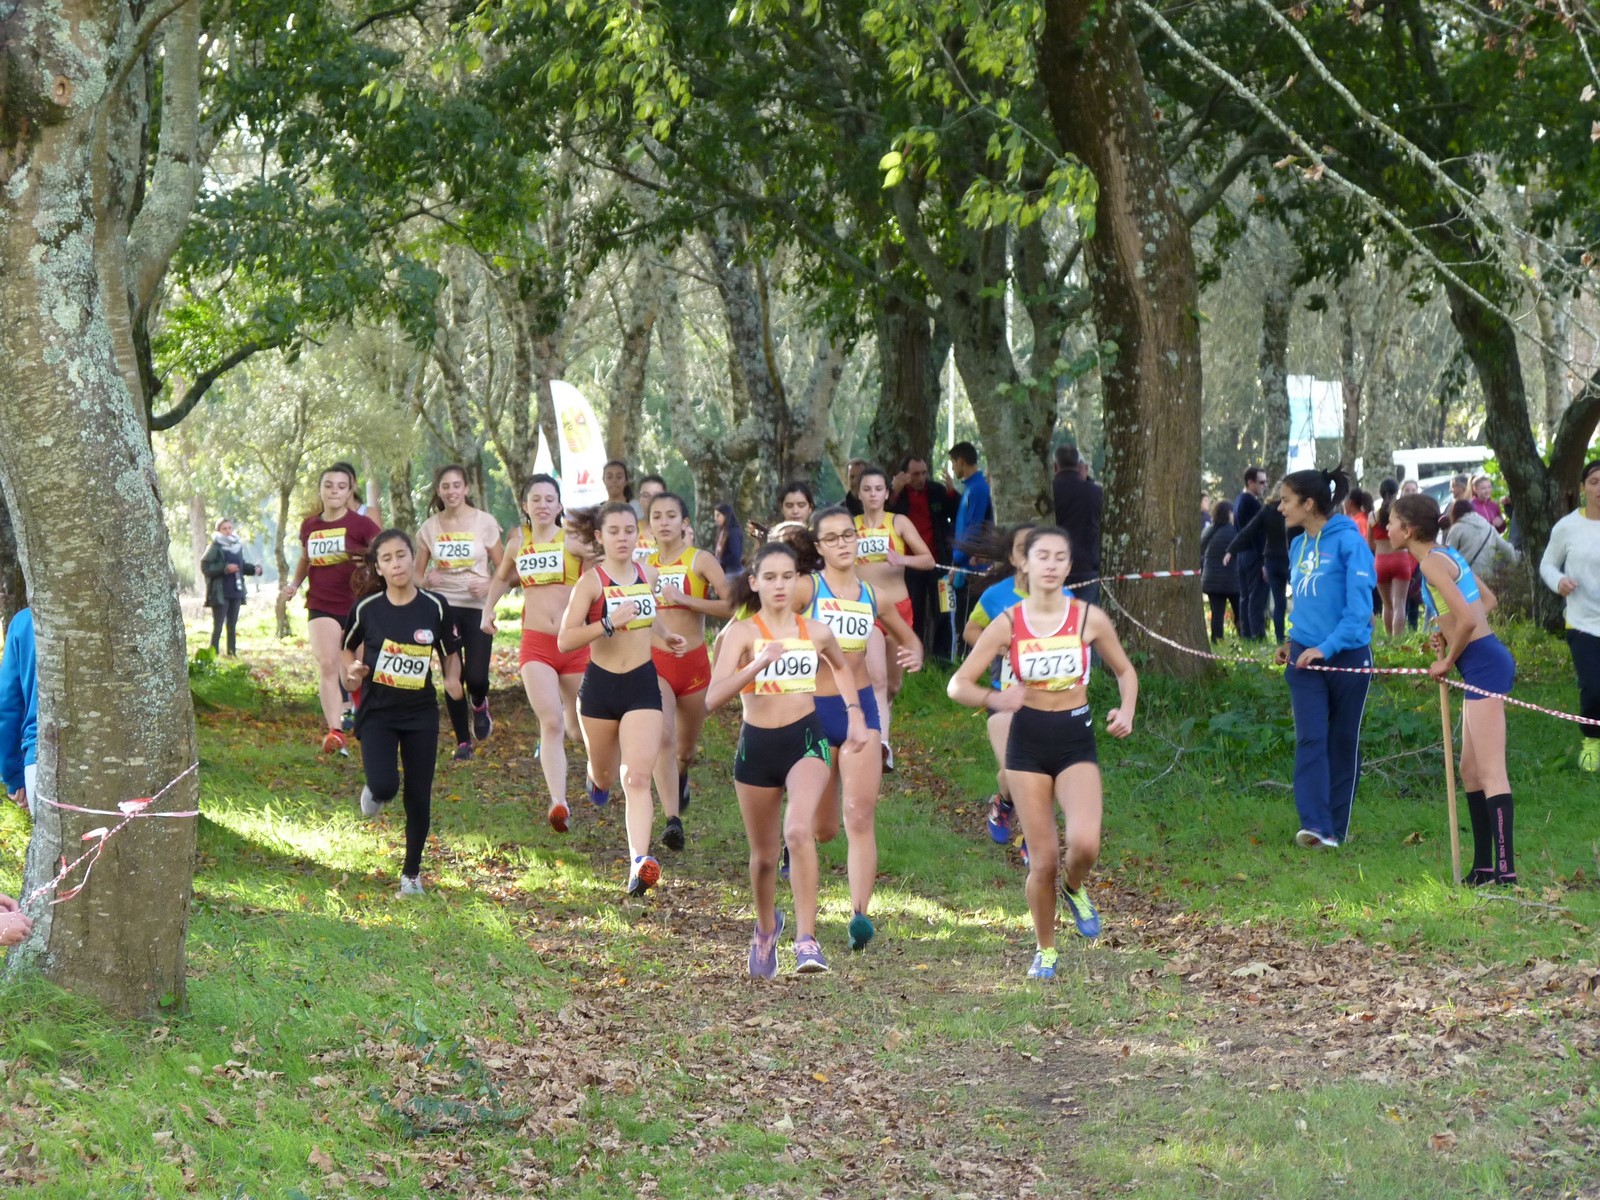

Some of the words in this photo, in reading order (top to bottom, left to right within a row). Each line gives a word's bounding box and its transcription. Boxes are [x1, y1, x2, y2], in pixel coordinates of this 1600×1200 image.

[311, 539, 341, 555] 7021
[438, 544, 470, 557] 7285
[520, 555, 558, 571] 2993
[823, 614, 868, 636] 7108
[382, 654, 424, 675] 7099
[1026, 653, 1076, 677] 7373
